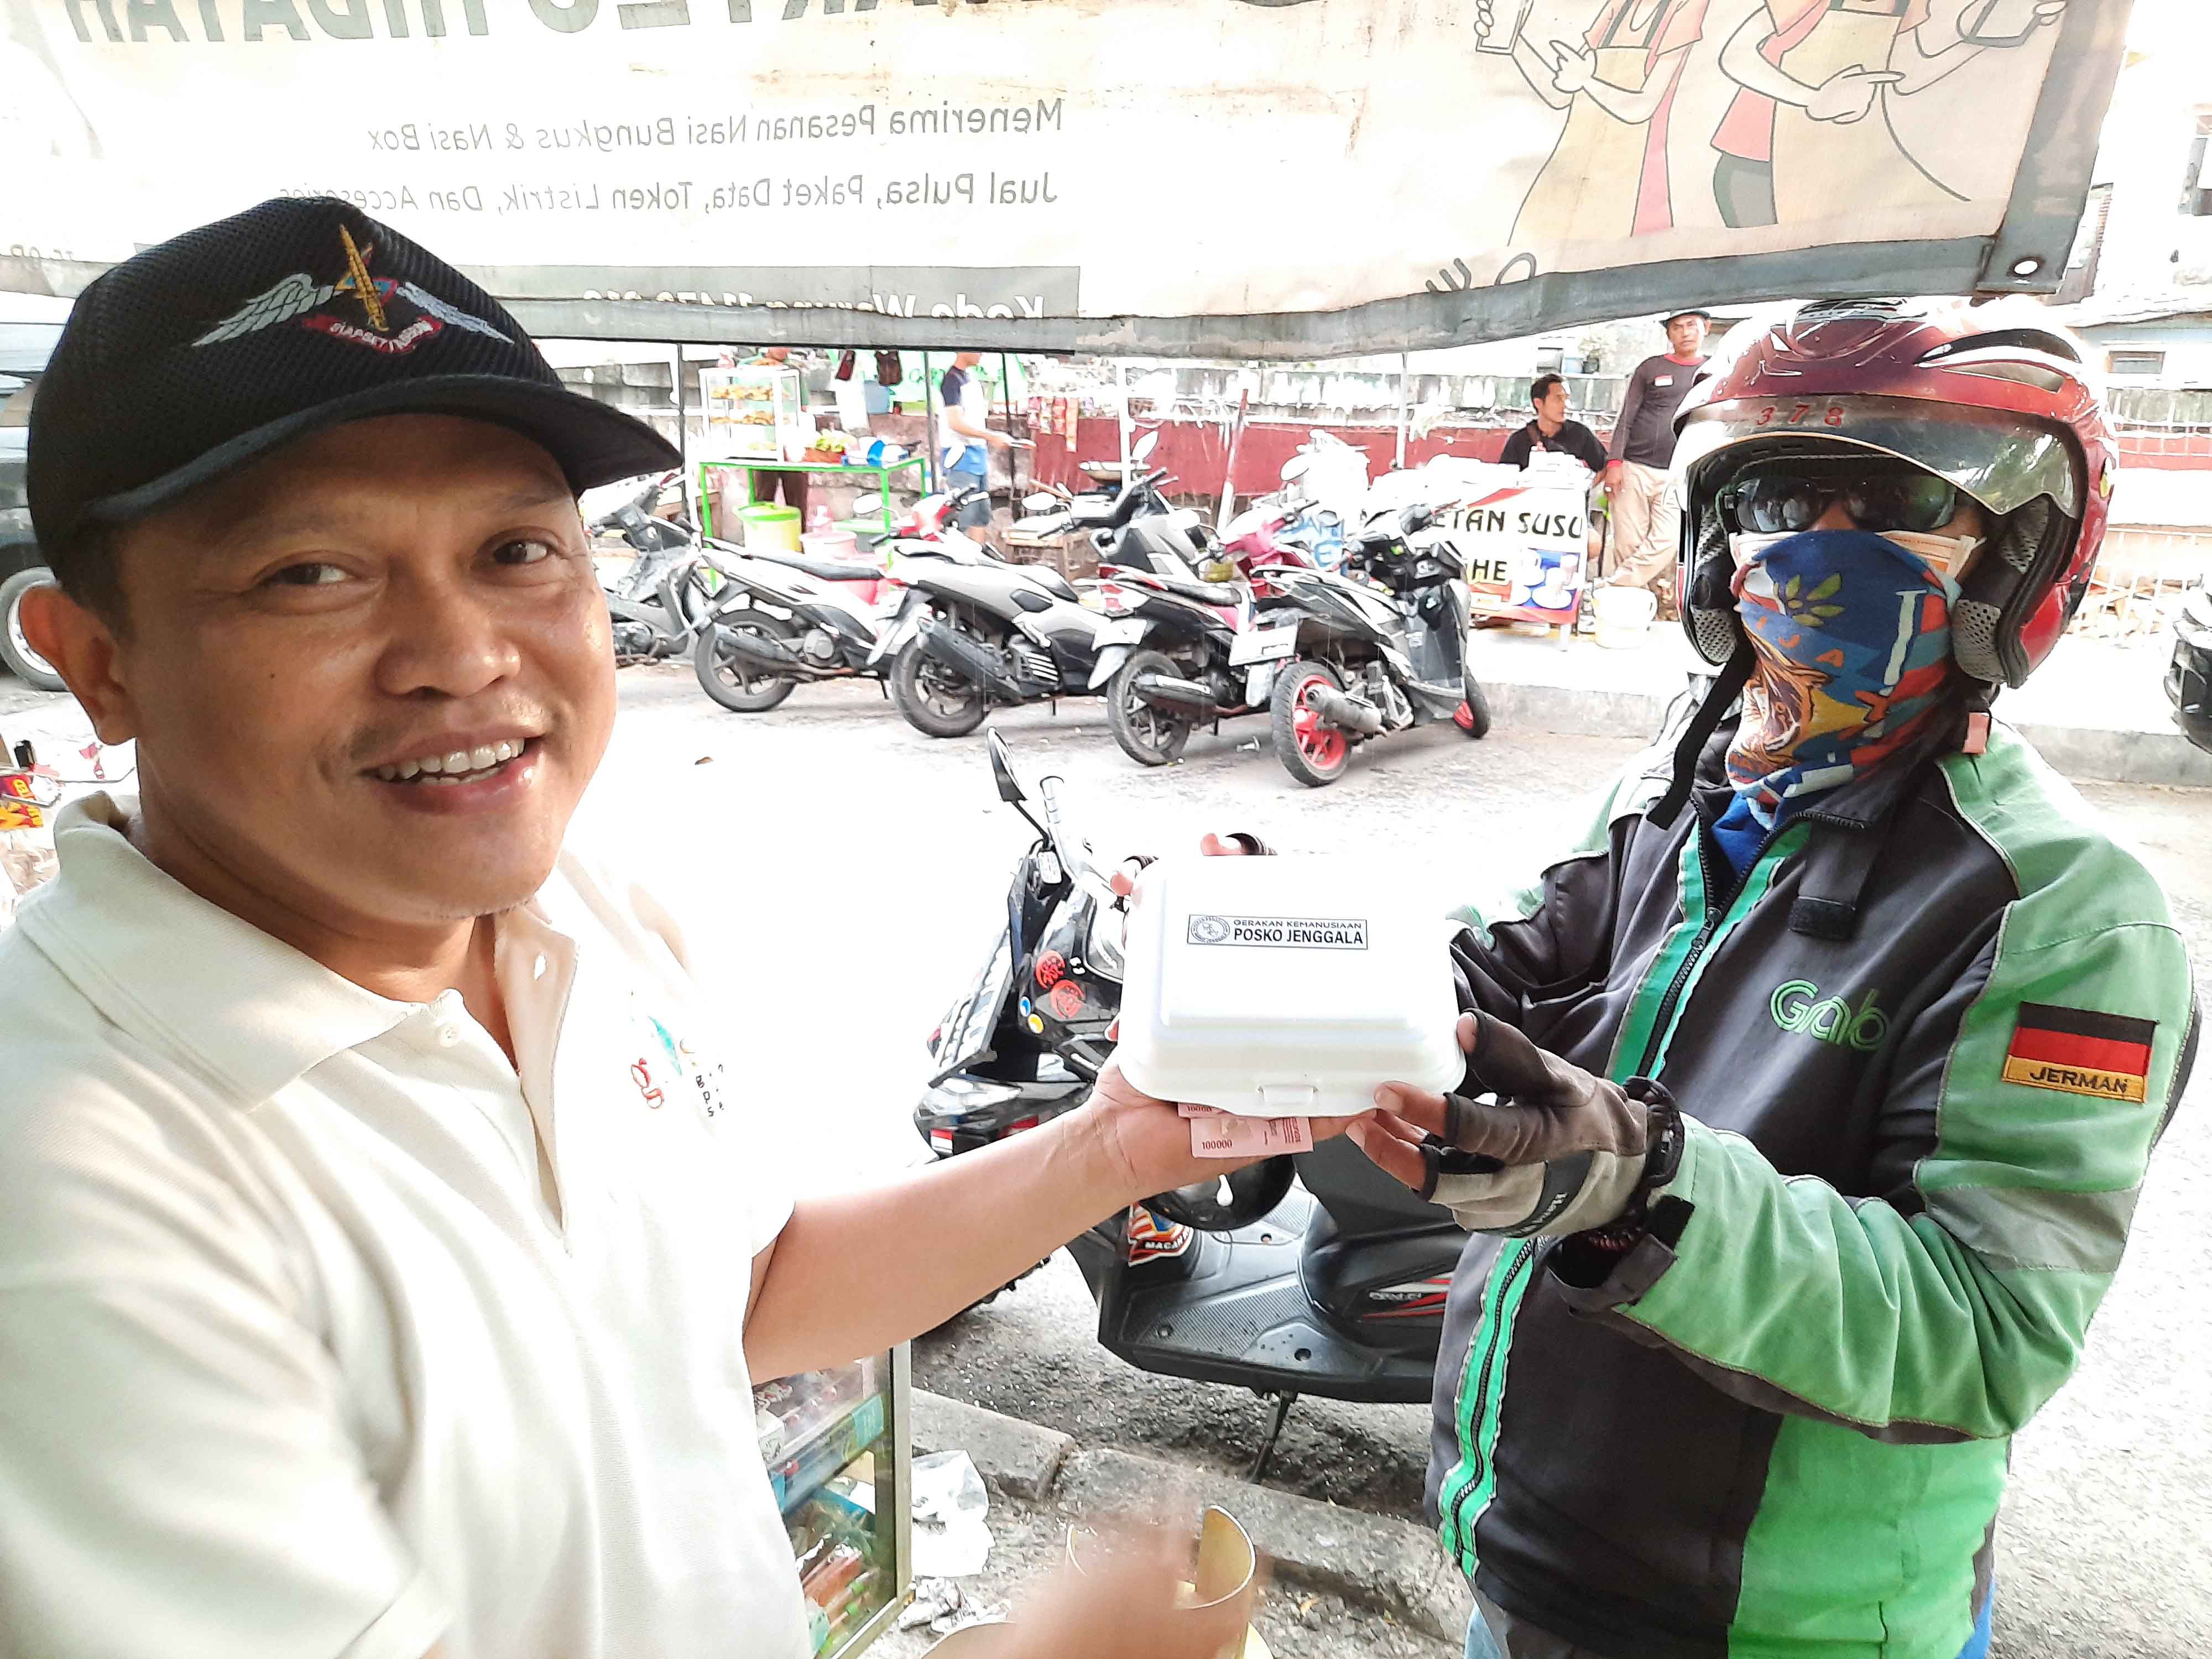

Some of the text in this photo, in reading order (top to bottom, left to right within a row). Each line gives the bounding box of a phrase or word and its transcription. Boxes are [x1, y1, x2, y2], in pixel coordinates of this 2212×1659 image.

[1432, 508, 1583, 539] ETAN SUSU
[1472, 559, 1507, 581] HE
[1233, 919, 1362, 930] GERAKAN KEMANUSIAAN
[1234, 928, 1282, 941] POSKO
[1286, 928, 1363, 945] JENGGALA
[1770, 978, 1886, 1050] Grab
[2030, 1066, 2129, 1094] JERMAN
[1201, 1139, 1233, 1150] 100000
